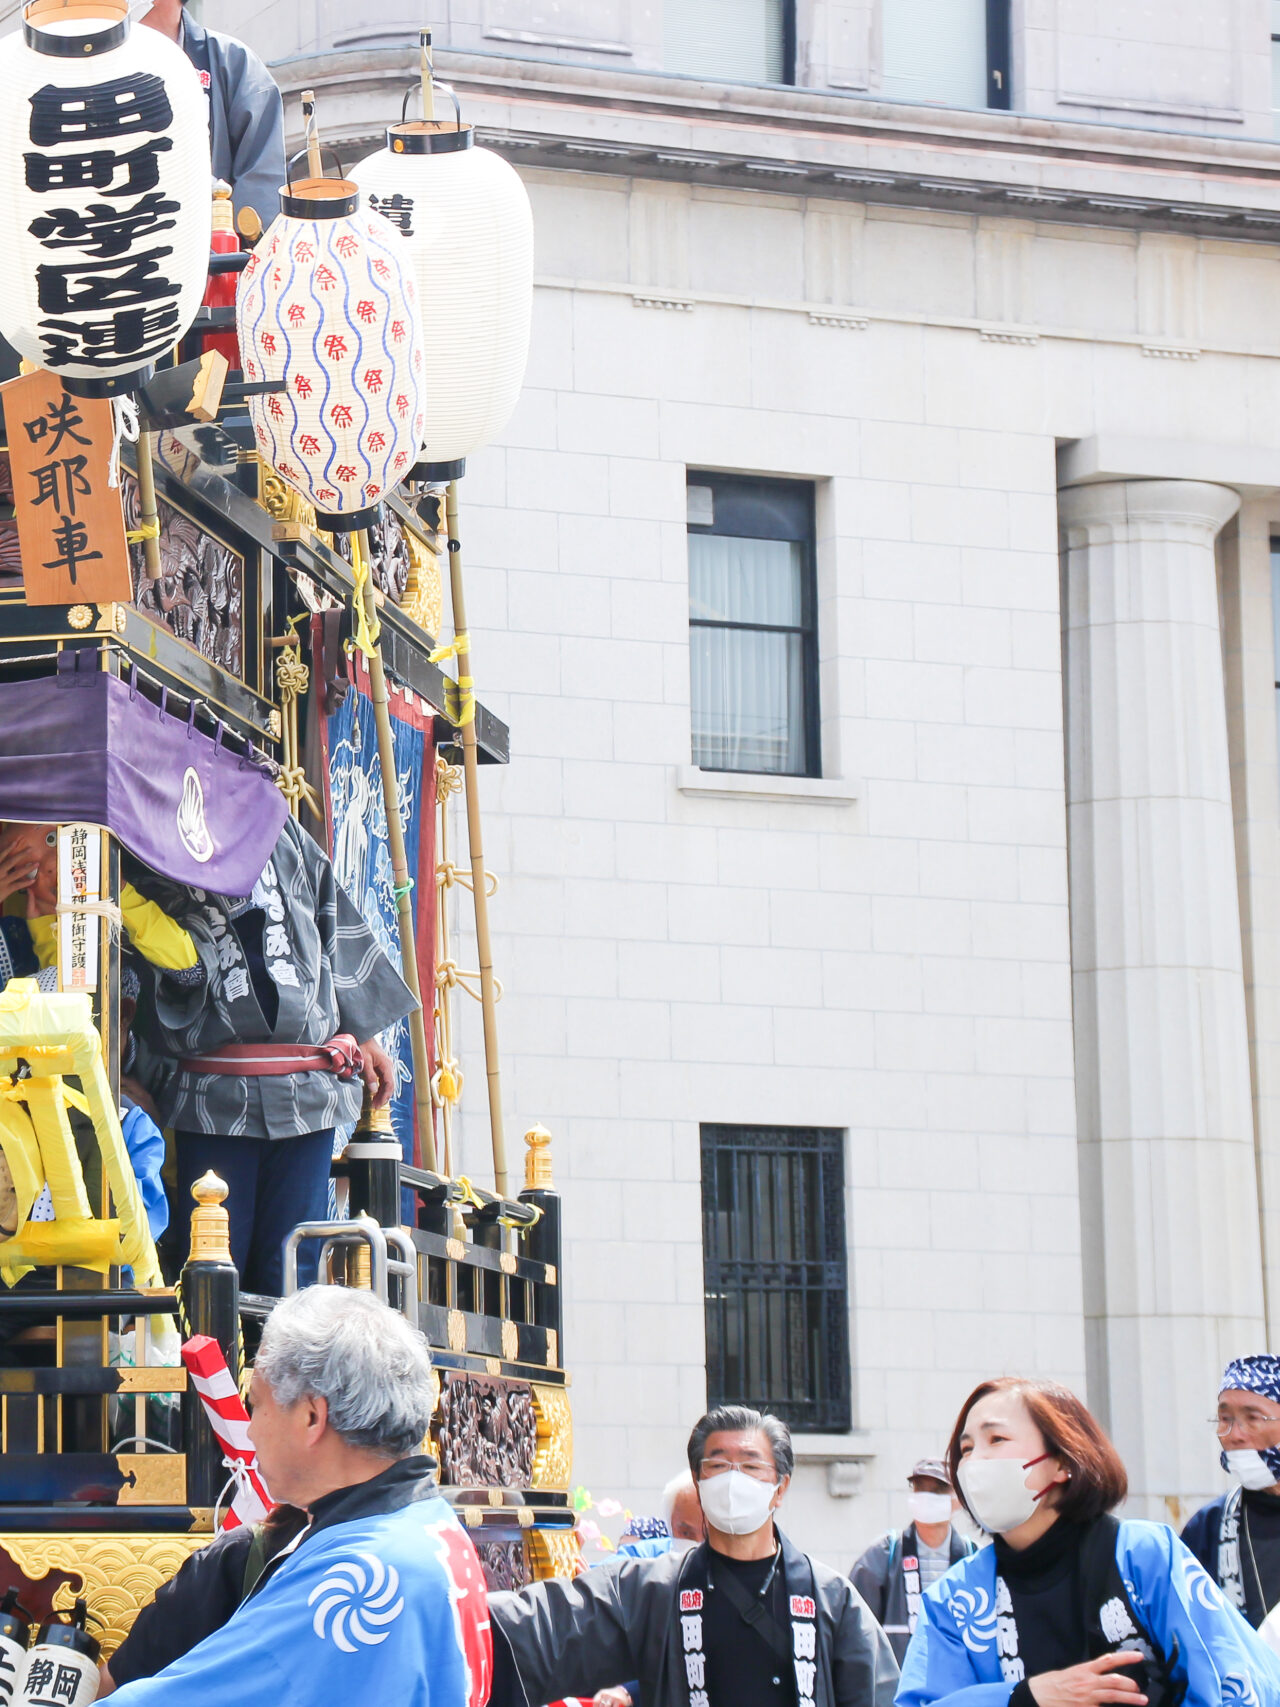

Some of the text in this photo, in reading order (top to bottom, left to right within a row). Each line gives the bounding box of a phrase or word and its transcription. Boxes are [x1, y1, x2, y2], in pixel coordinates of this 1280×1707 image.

[22, 72, 182, 367] 田町学区連
[324, 335, 348, 361] 祭
[364, 369, 383, 393] 祭
[331, 403, 352, 429] 祭
[368, 432, 386, 456] 祭
[23, 392, 103, 585] 咲耶車
